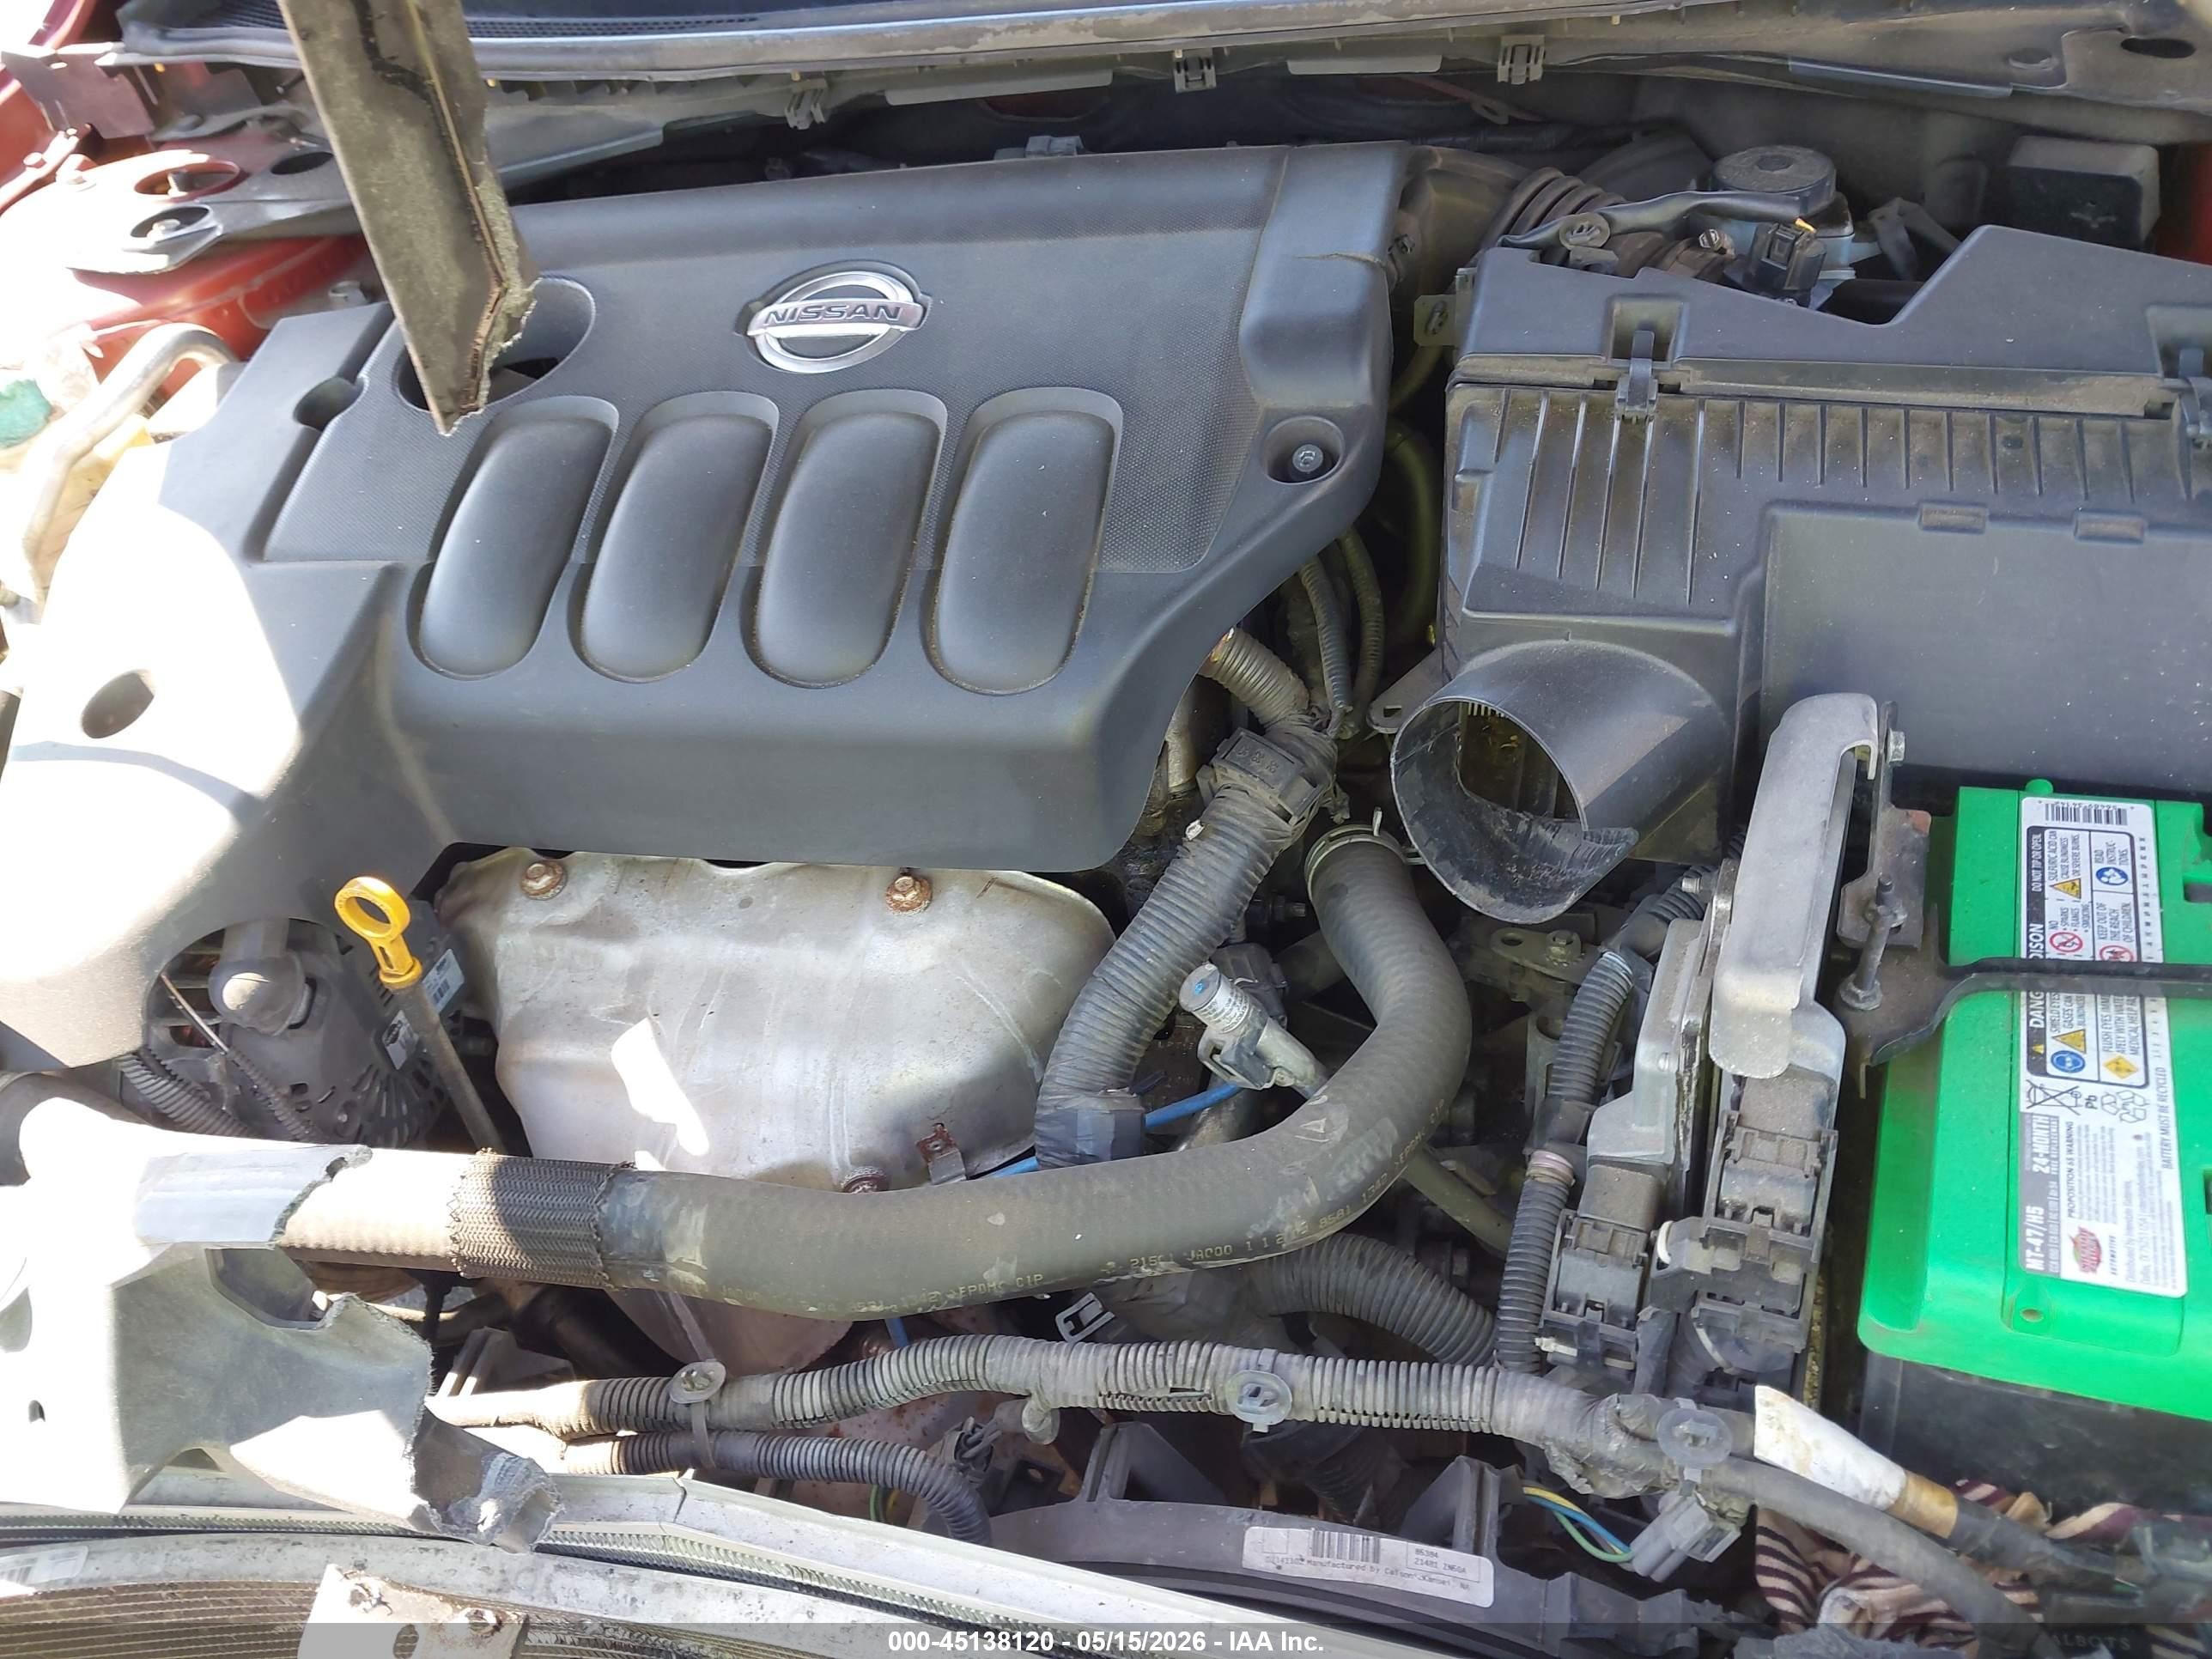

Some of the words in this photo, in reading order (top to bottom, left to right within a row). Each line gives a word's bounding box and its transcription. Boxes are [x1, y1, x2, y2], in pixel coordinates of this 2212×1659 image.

[764, 305, 901, 325] NISSAN
[2032, 850, 2041, 859] OR
[2049, 841, 2057, 853] ACID
[2060, 838, 2069, 863] BLINDNESS
[2032, 860, 2041, 868] TIP
[2048, 855, 2057, 880] SULFURIC
[2032, 869, 2041, 881] NOT
[2032, 883, 2041, 891] DO
[2049, 921, 2057, 930] NO
[2071, 908, 2080, 927] FLAMES
[2097, 912, 2106, 924] OUT
[2109, 909, 2118, 928] REACH
[2029, 923, 2044, 958] OISON
[2098, 925, 2107, 940] KEEP
[2110, 930, 2119, 940] THE
[2029, 992, 2045, 1028] DANG
[2064, 995, 2073, 1007] CAN
[2076, 995, 2086, 1026] BLINDNESS
[2113, 996, 2124, 1015] WATE
[2050, 1009, 2061, 1032] SHIELD
[2063, 1008, 2074, 1029] GASES
[2100, 1015, 2112, 1030] EYES
[2114, 1017, 2124, 1033] WITH
[2127, 1008, 2138, 1024] HELP
[2101, 1032, 2113, 1052] FLUSH
[2114, 1036, 2126, 1054] ATELY
[2128, 1026, 2139, 1055] MEDICAL
[2154, 1067, 2167, 1103] RECYCLED
[2085, 1095, 2098, 1109] Pb
[2159, 1115, 2171, 1135] MUST
[2032, 1115, 2051, 1174] 24-MONTH
[2065, 1121, 2074, 1154] WARNING
[2160, 1138, 2173, 1169] BATTERY
[2066, 1167, 2075, 1218] PROPOSITION
[2023, 1206, 2047, 1271] MT-47/H5
[2109, 1235, 2118, 1276] AUTOMOTIVE
[1307, 1559, 1366, 1571] Manufactured
[1370, 1564, 1381, 1574] by
[2051, 1633, 2130, 1650] ALBOTS
